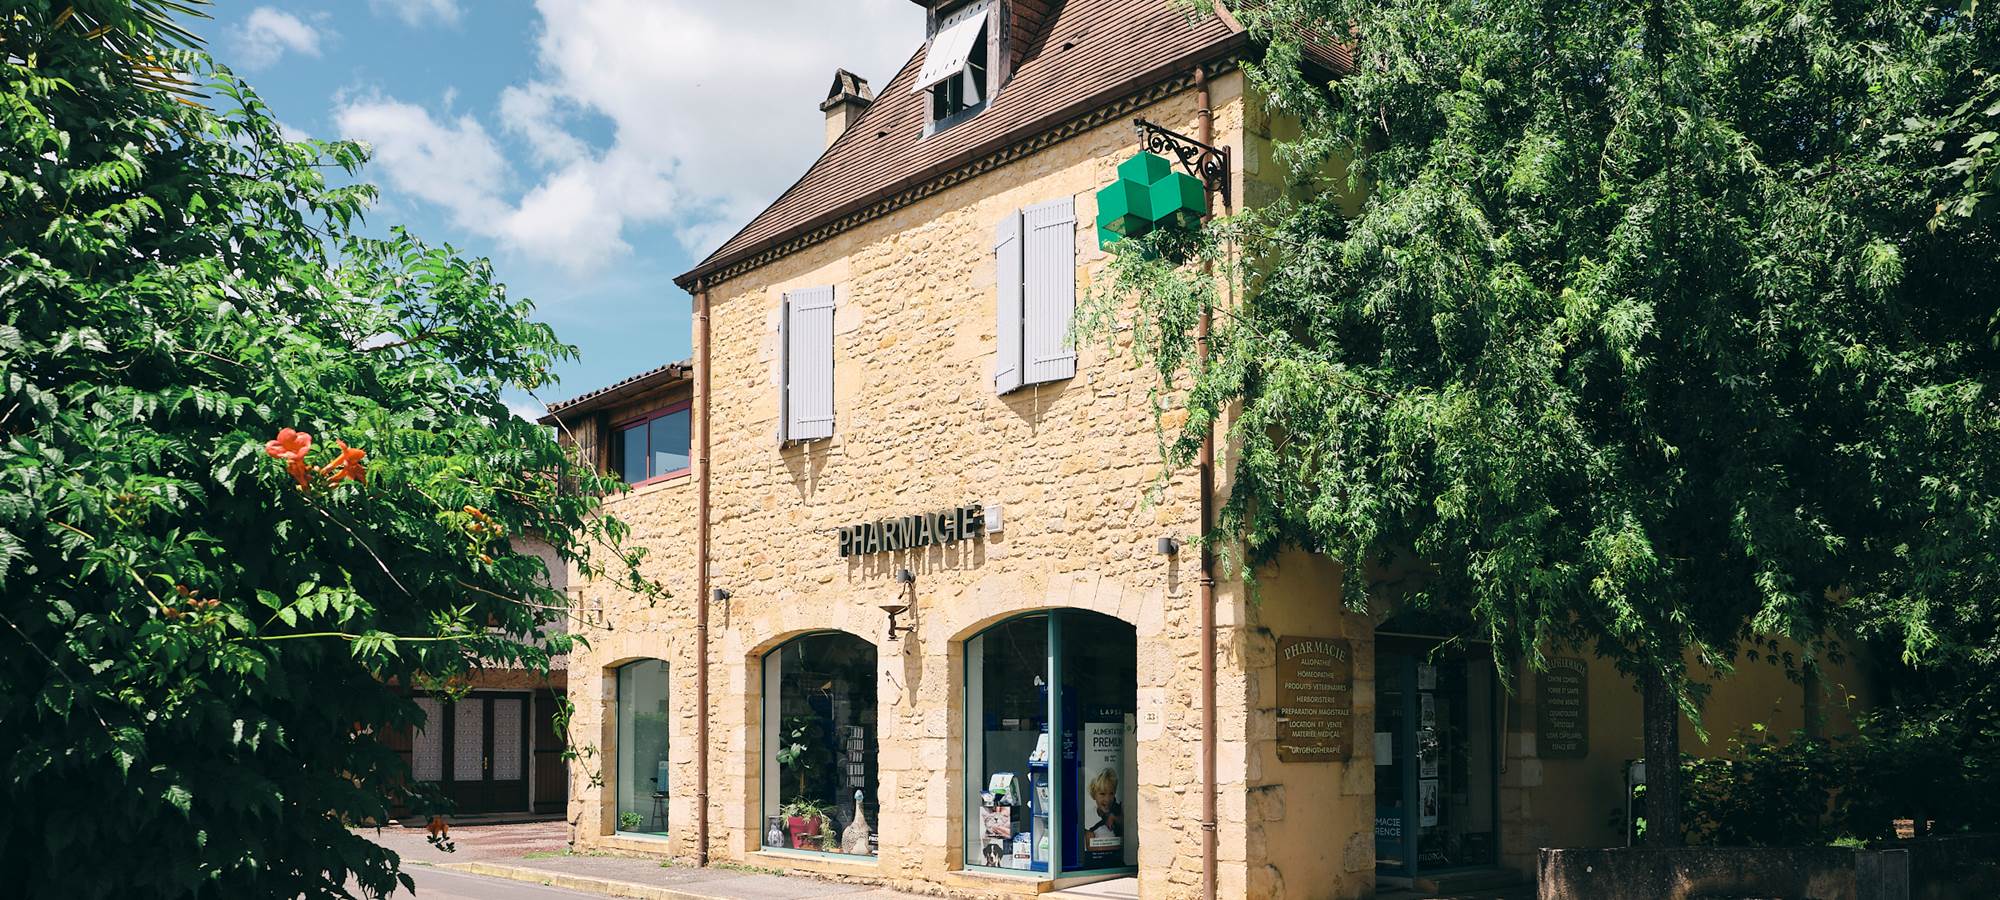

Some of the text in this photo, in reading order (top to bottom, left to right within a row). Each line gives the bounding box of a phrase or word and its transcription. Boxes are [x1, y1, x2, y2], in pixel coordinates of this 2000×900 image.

[839, 504, 983, 558] PHARMACIE
[1284, 641, 1346, 662] PHARMACIE
[1284, 682, 1312, 690] PRODUITS
[1281, 707, 1317, 716] PREPARATION
[1289, 720, 1315, 728] LOCATION
[1327, 721, 1342, 729] VENTE
